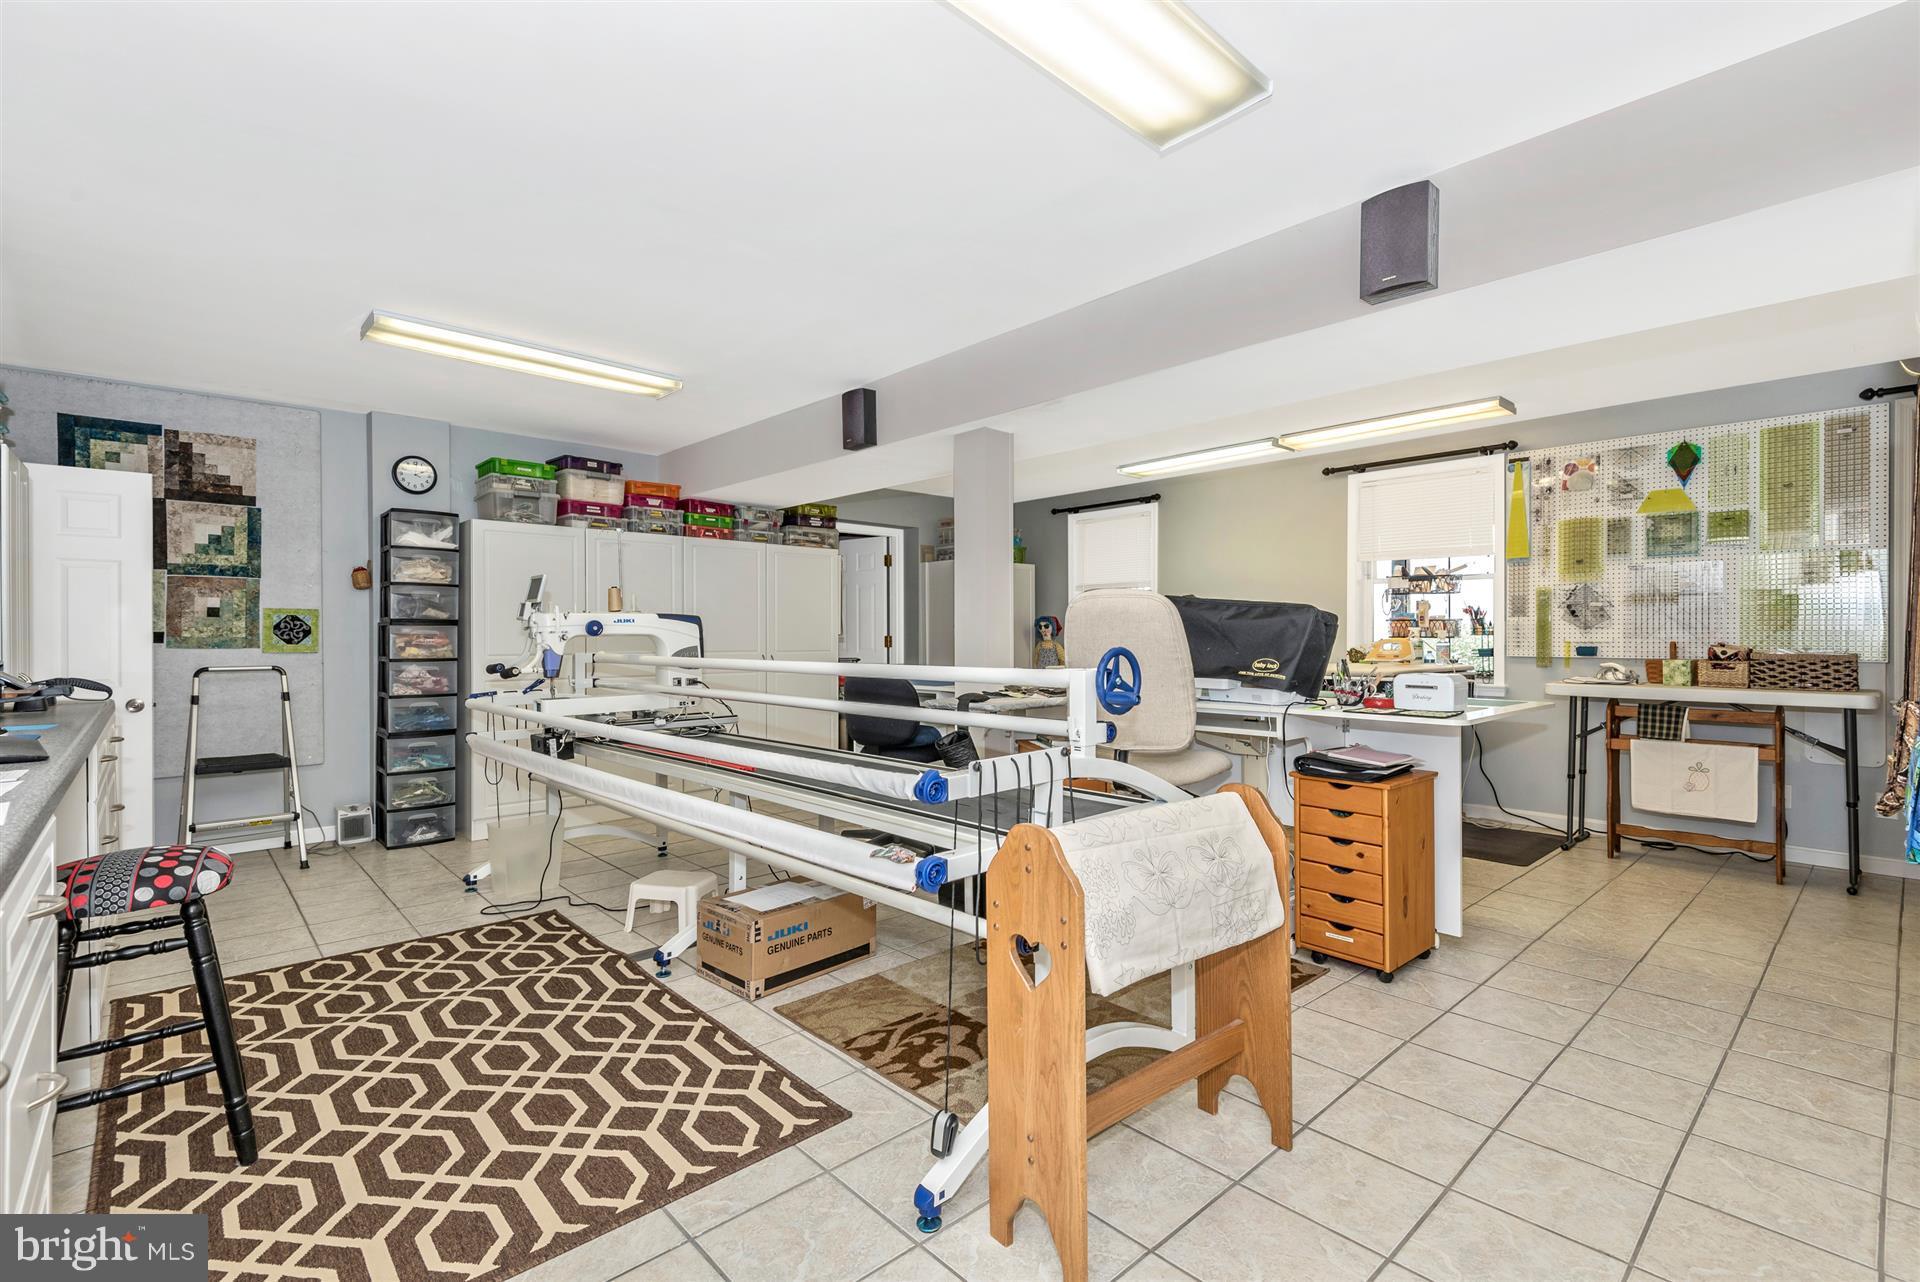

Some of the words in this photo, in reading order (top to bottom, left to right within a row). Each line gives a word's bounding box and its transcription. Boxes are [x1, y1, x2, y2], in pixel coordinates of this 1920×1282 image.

[766, 935, 806, 956] GENUINE
[806, 927, 833, 943] PARTS
[767, 919, 809, 942] JUKI
[702, 931, 725, 949] GENUINE
[725, 941, 743, 956] PARTS
